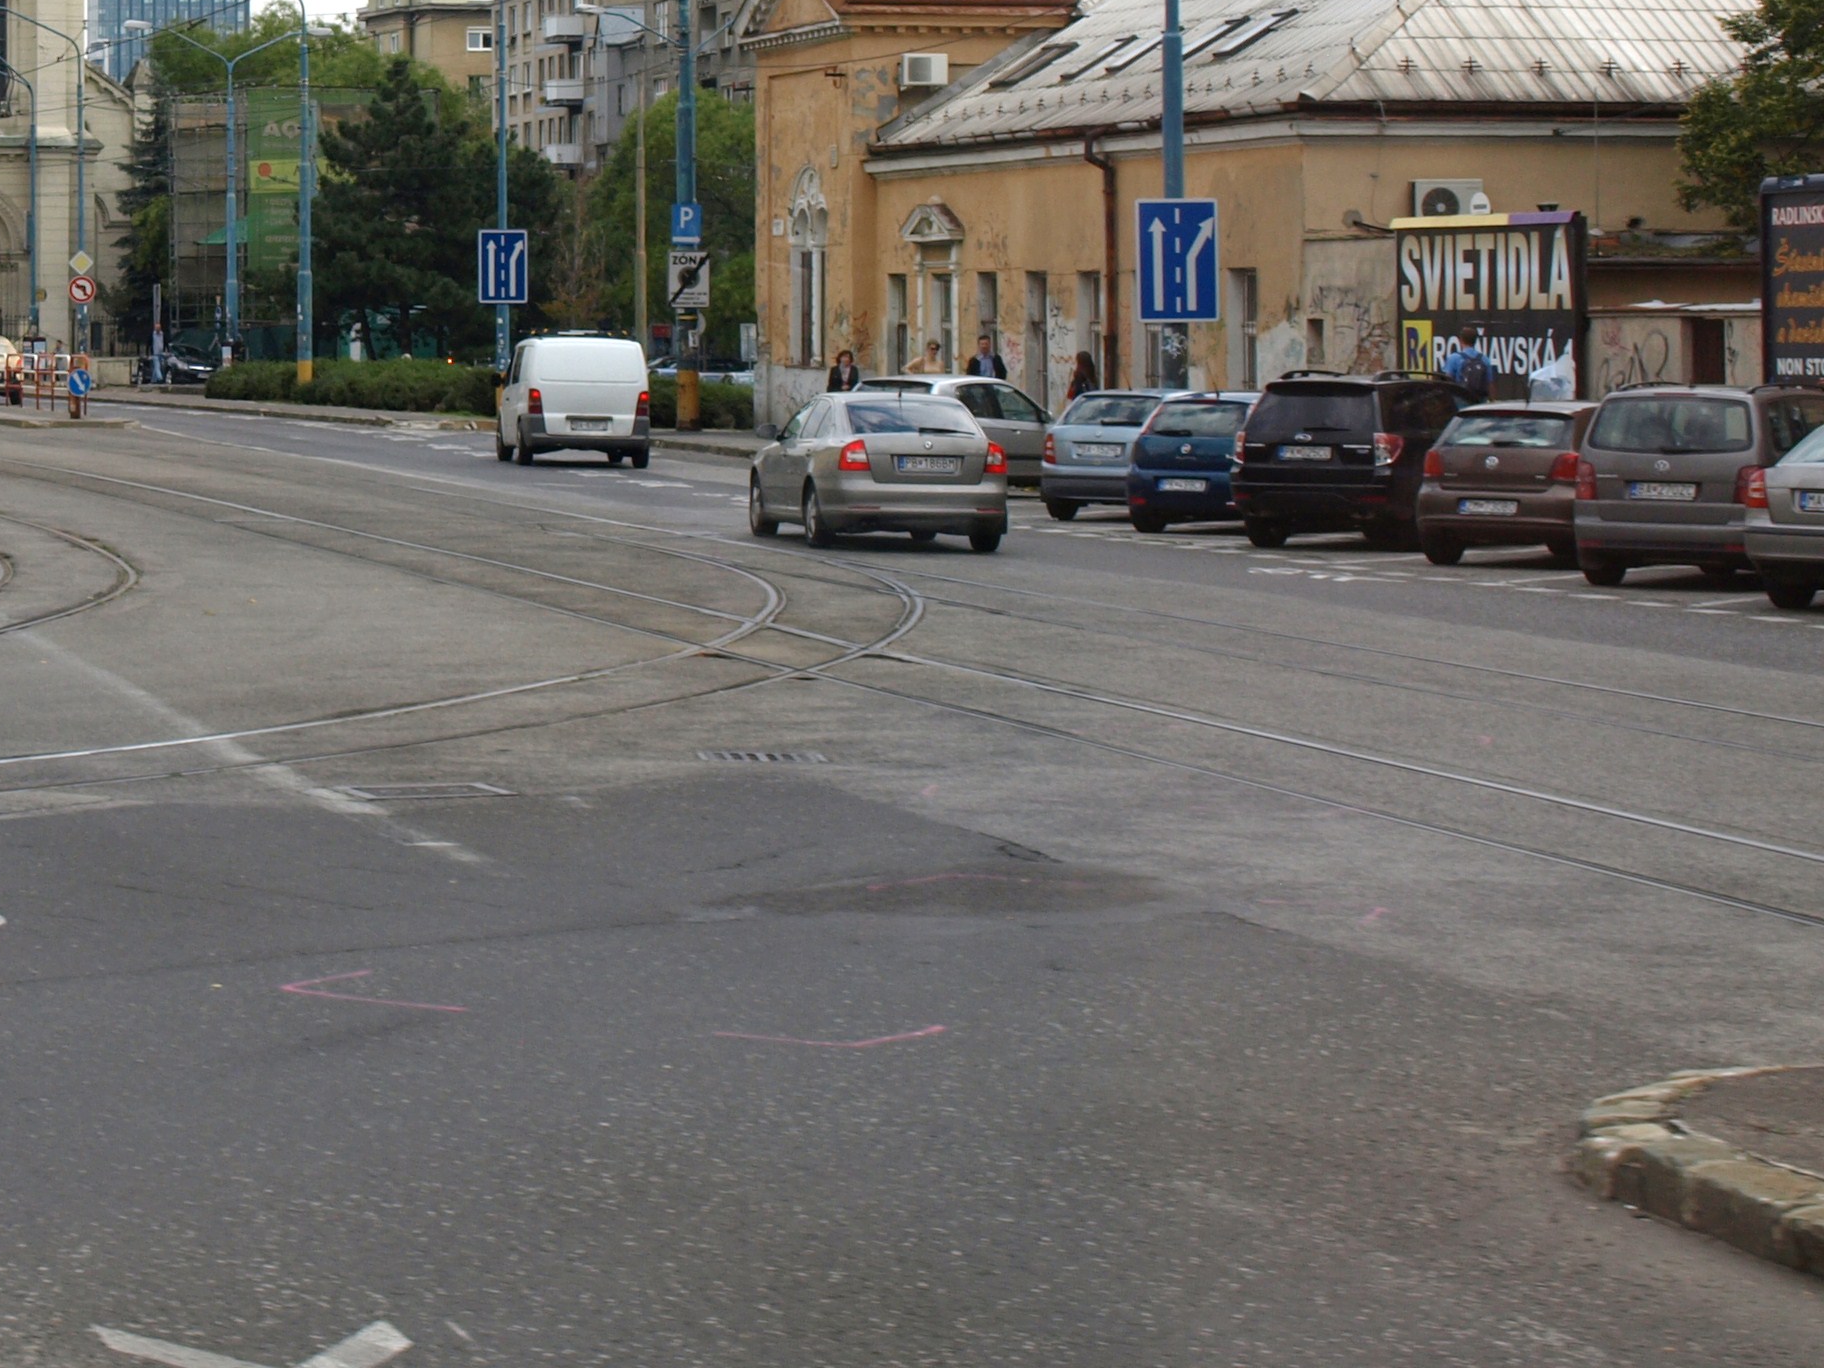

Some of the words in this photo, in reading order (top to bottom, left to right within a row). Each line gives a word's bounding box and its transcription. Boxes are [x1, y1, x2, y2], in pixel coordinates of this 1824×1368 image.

[262, 120, 302, 139] AQ
[1400, 225, 1573, 313] SVIETIDLÁ
[1433, 328, 1557, 375] ROŇAVSKÁ
[1777, 358, 1803, 376] NON
[1806, 357, 1824, 376] STO
